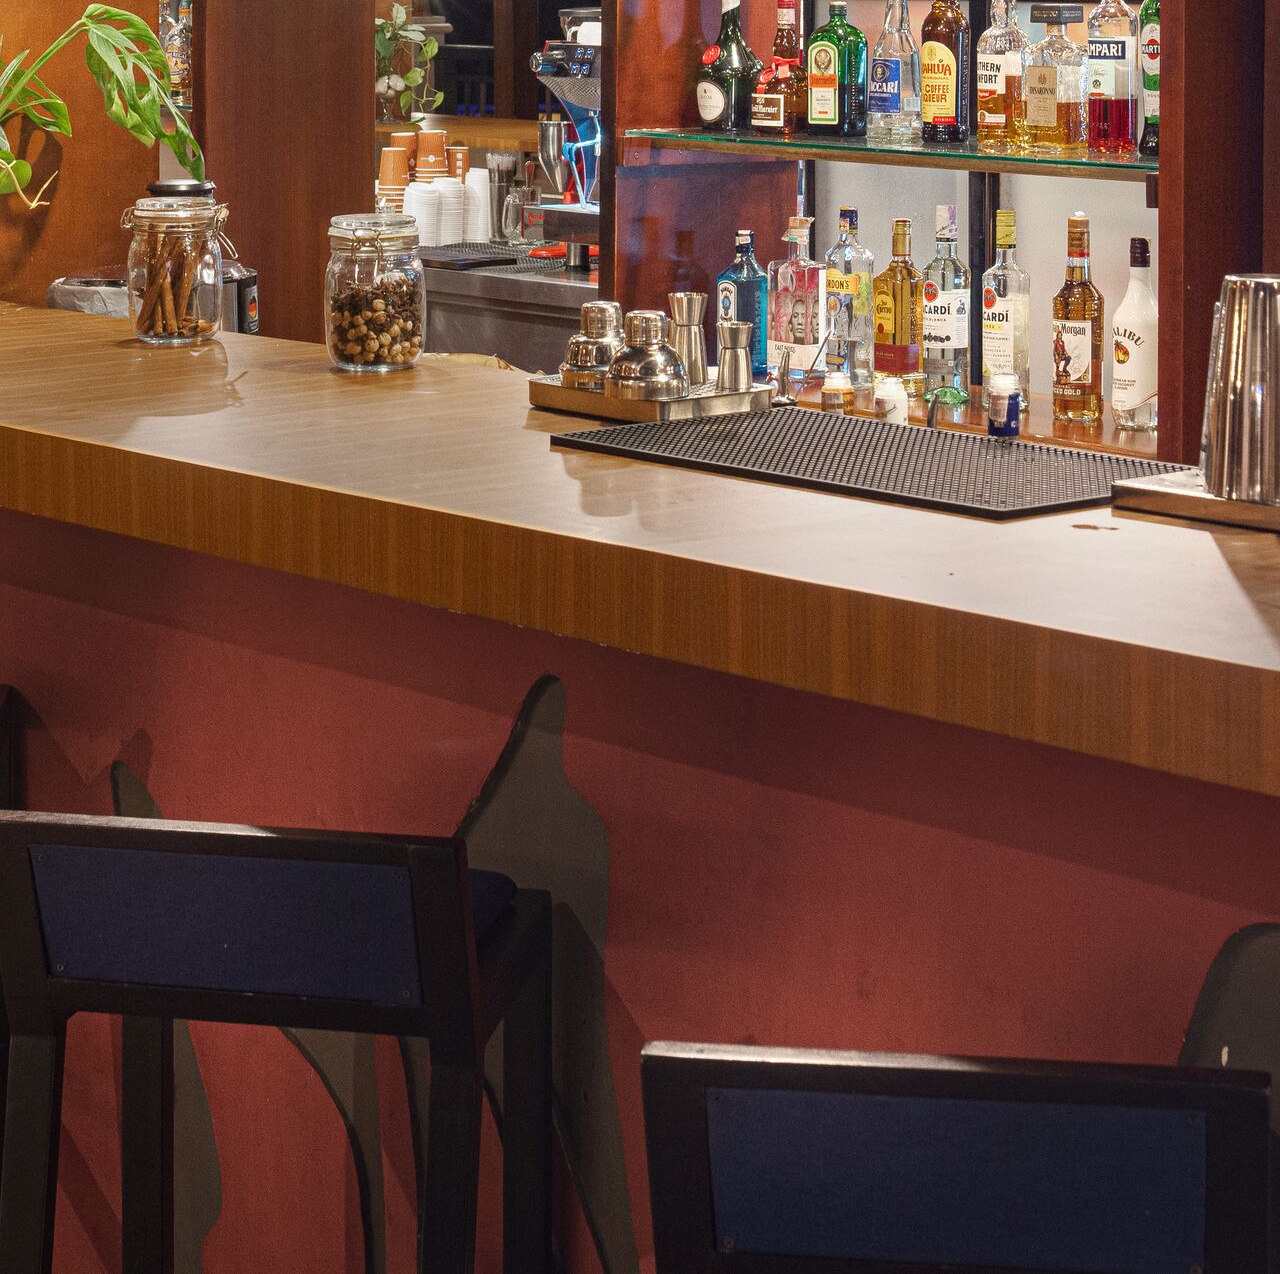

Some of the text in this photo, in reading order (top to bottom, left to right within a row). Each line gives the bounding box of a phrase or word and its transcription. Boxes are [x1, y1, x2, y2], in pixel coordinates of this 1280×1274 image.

[925, 84, 950, 94] COFFEE
[1029, 86, 1056, 96] DISARONNO
[1061, 323, 1086, 336] Morgan
[1064, 388, 1081, 396] GOLD
